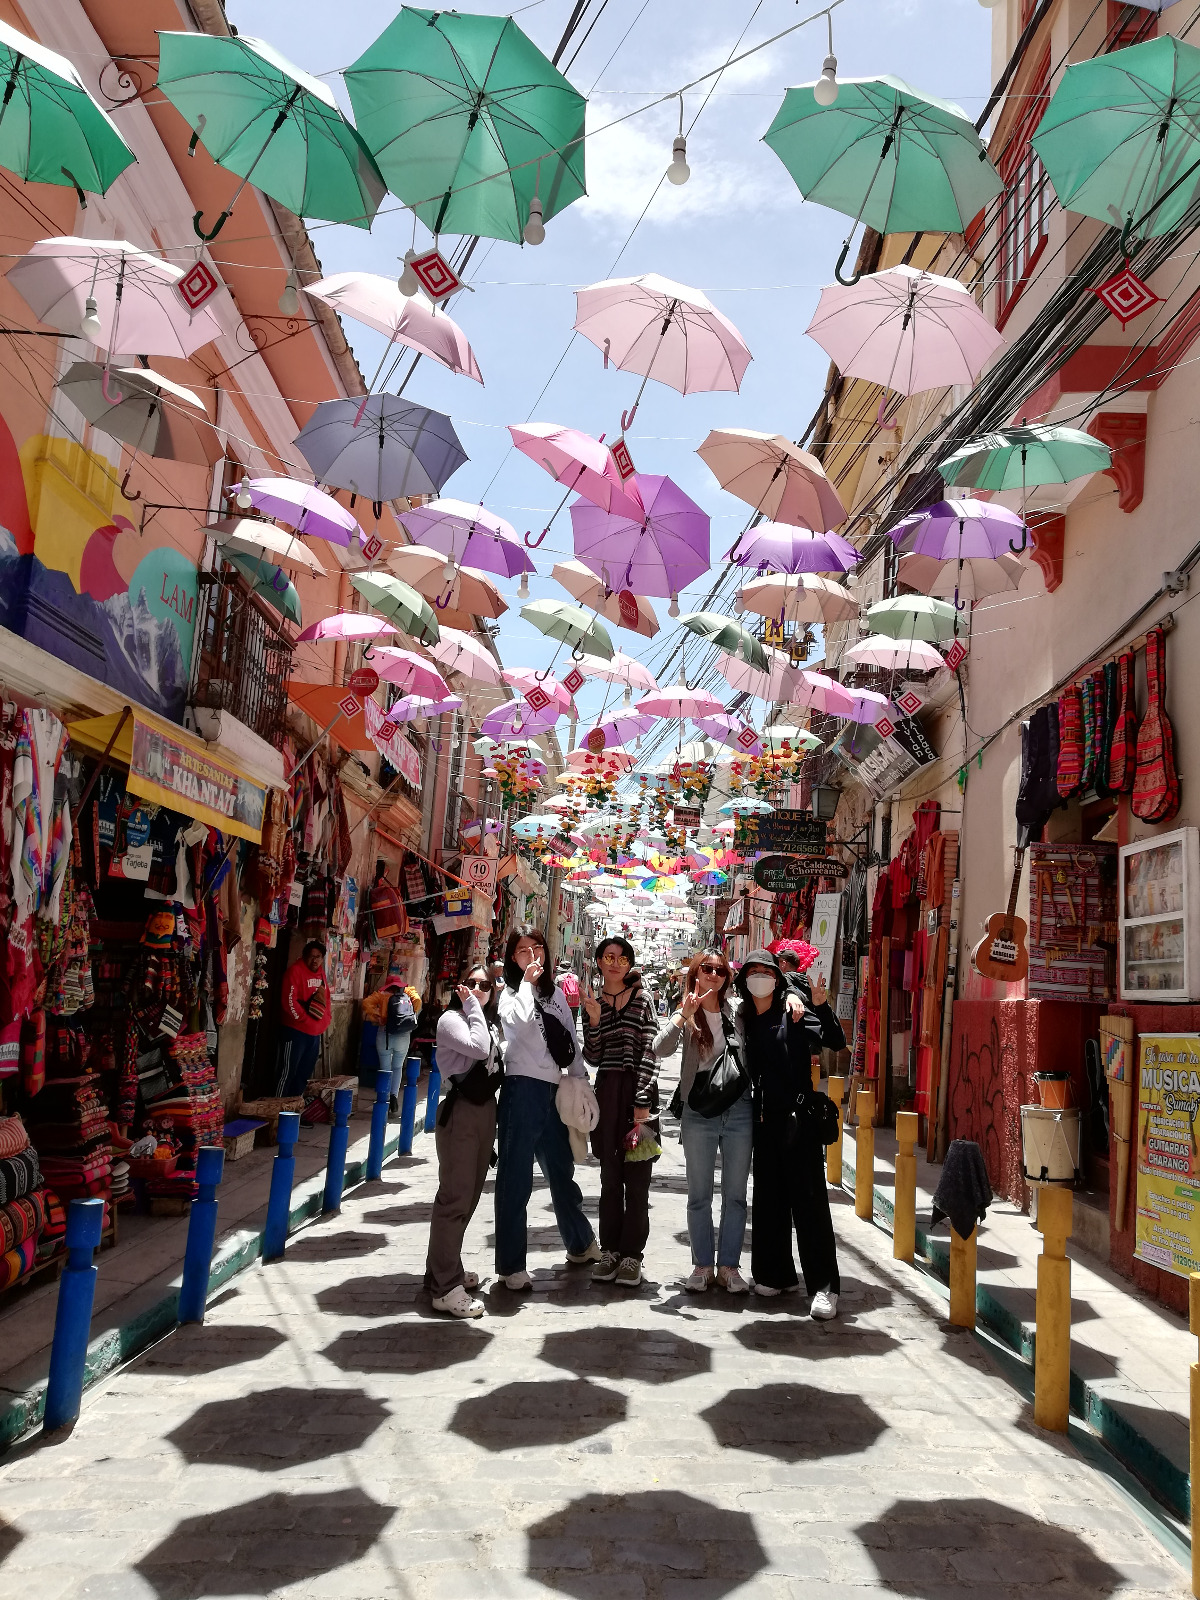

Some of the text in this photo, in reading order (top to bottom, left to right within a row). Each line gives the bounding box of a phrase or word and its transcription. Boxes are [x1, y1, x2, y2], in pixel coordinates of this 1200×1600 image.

[759, 811, 826, 822] ANTIQUE-P
[782, 843, 824, 854] 71265667
[125, 857, 148, 869] Tarjeta
[473, 863, 486, 874] 10
[803, 860, 837, 869] Caldero
[792, 867, 843, 876] Chorreante
[1141, 1103, 1162, 1111] VENTA
[1184, 1132, 1191, 1141] DE
[1149, 1139, 1189, 1157] GUITARRAS
[1148, 1153, 1189, 1173] CHARANGO
[1176, 1200, 1195, 1212] pedido
